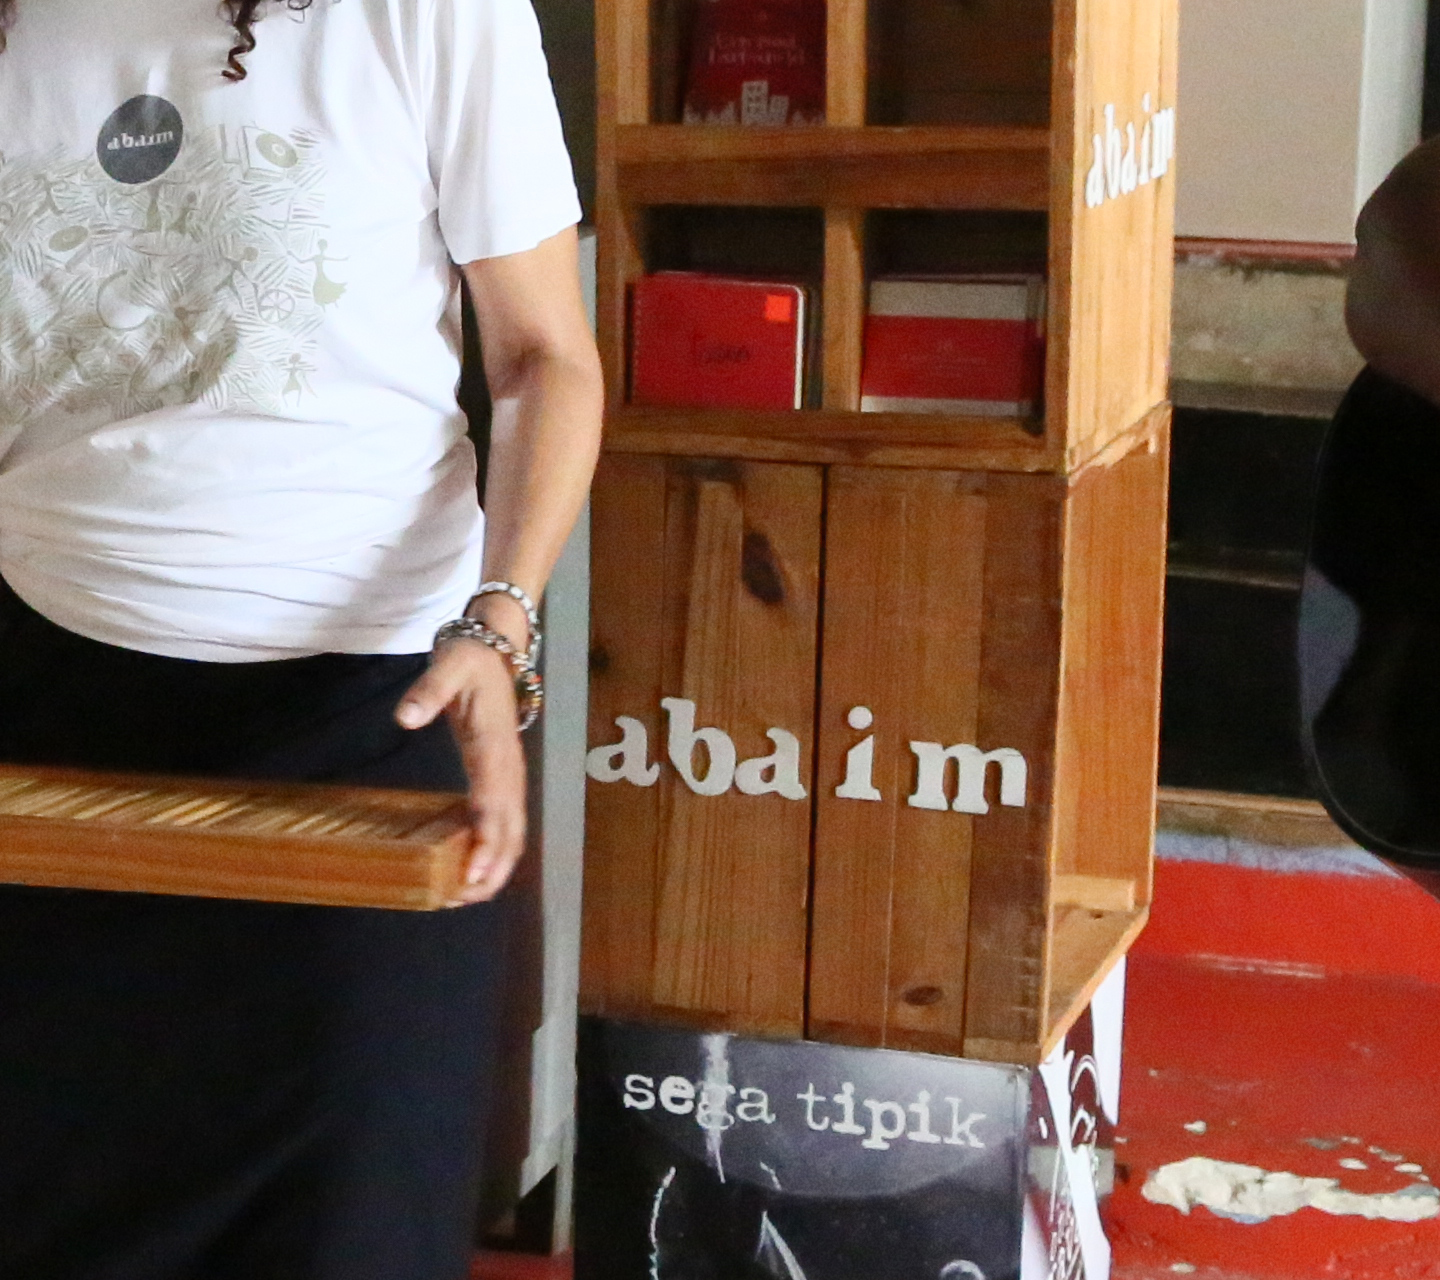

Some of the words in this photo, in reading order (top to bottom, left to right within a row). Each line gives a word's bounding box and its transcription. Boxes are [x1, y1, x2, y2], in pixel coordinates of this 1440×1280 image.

[106, 130, 174, 151] abaim
[1084, 91, 1175, 208] abaim
[585, 696, 1028, 815] abaim
[622, 1071, 776, 1132] sega
[796, 1082, 987, 1151] tipik
